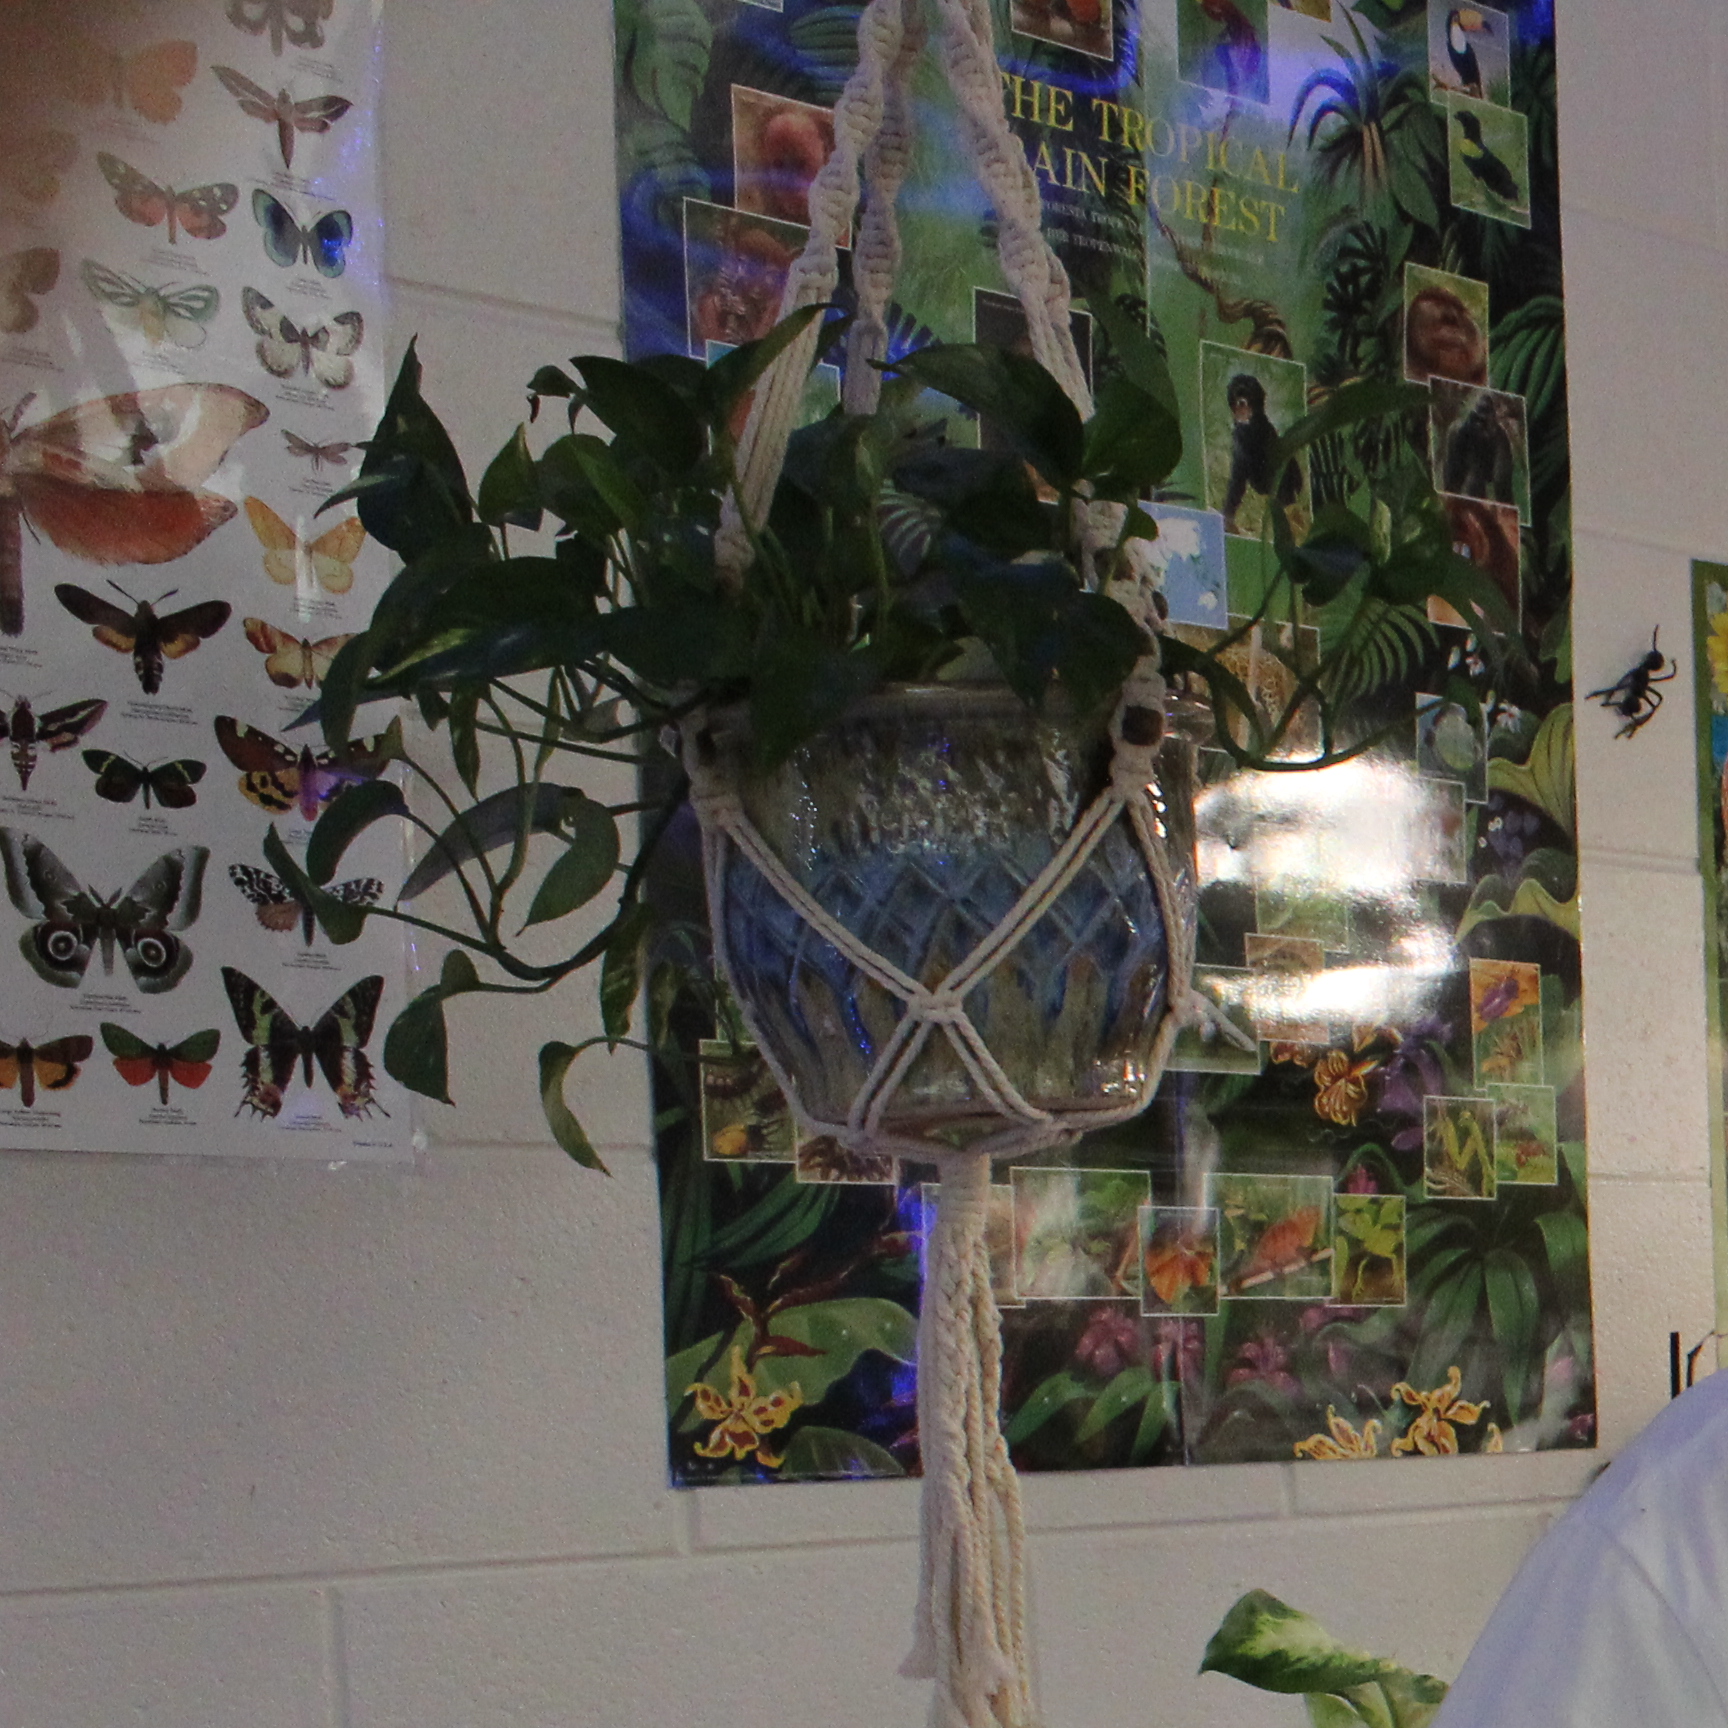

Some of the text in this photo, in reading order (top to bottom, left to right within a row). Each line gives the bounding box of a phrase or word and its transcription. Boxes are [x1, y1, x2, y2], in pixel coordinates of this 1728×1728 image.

[1033, 139, 1109, 198] AIN
[1126, 165, 1286, 243] FOREST
[1091, 98, 1300, 194] TROPICAL
